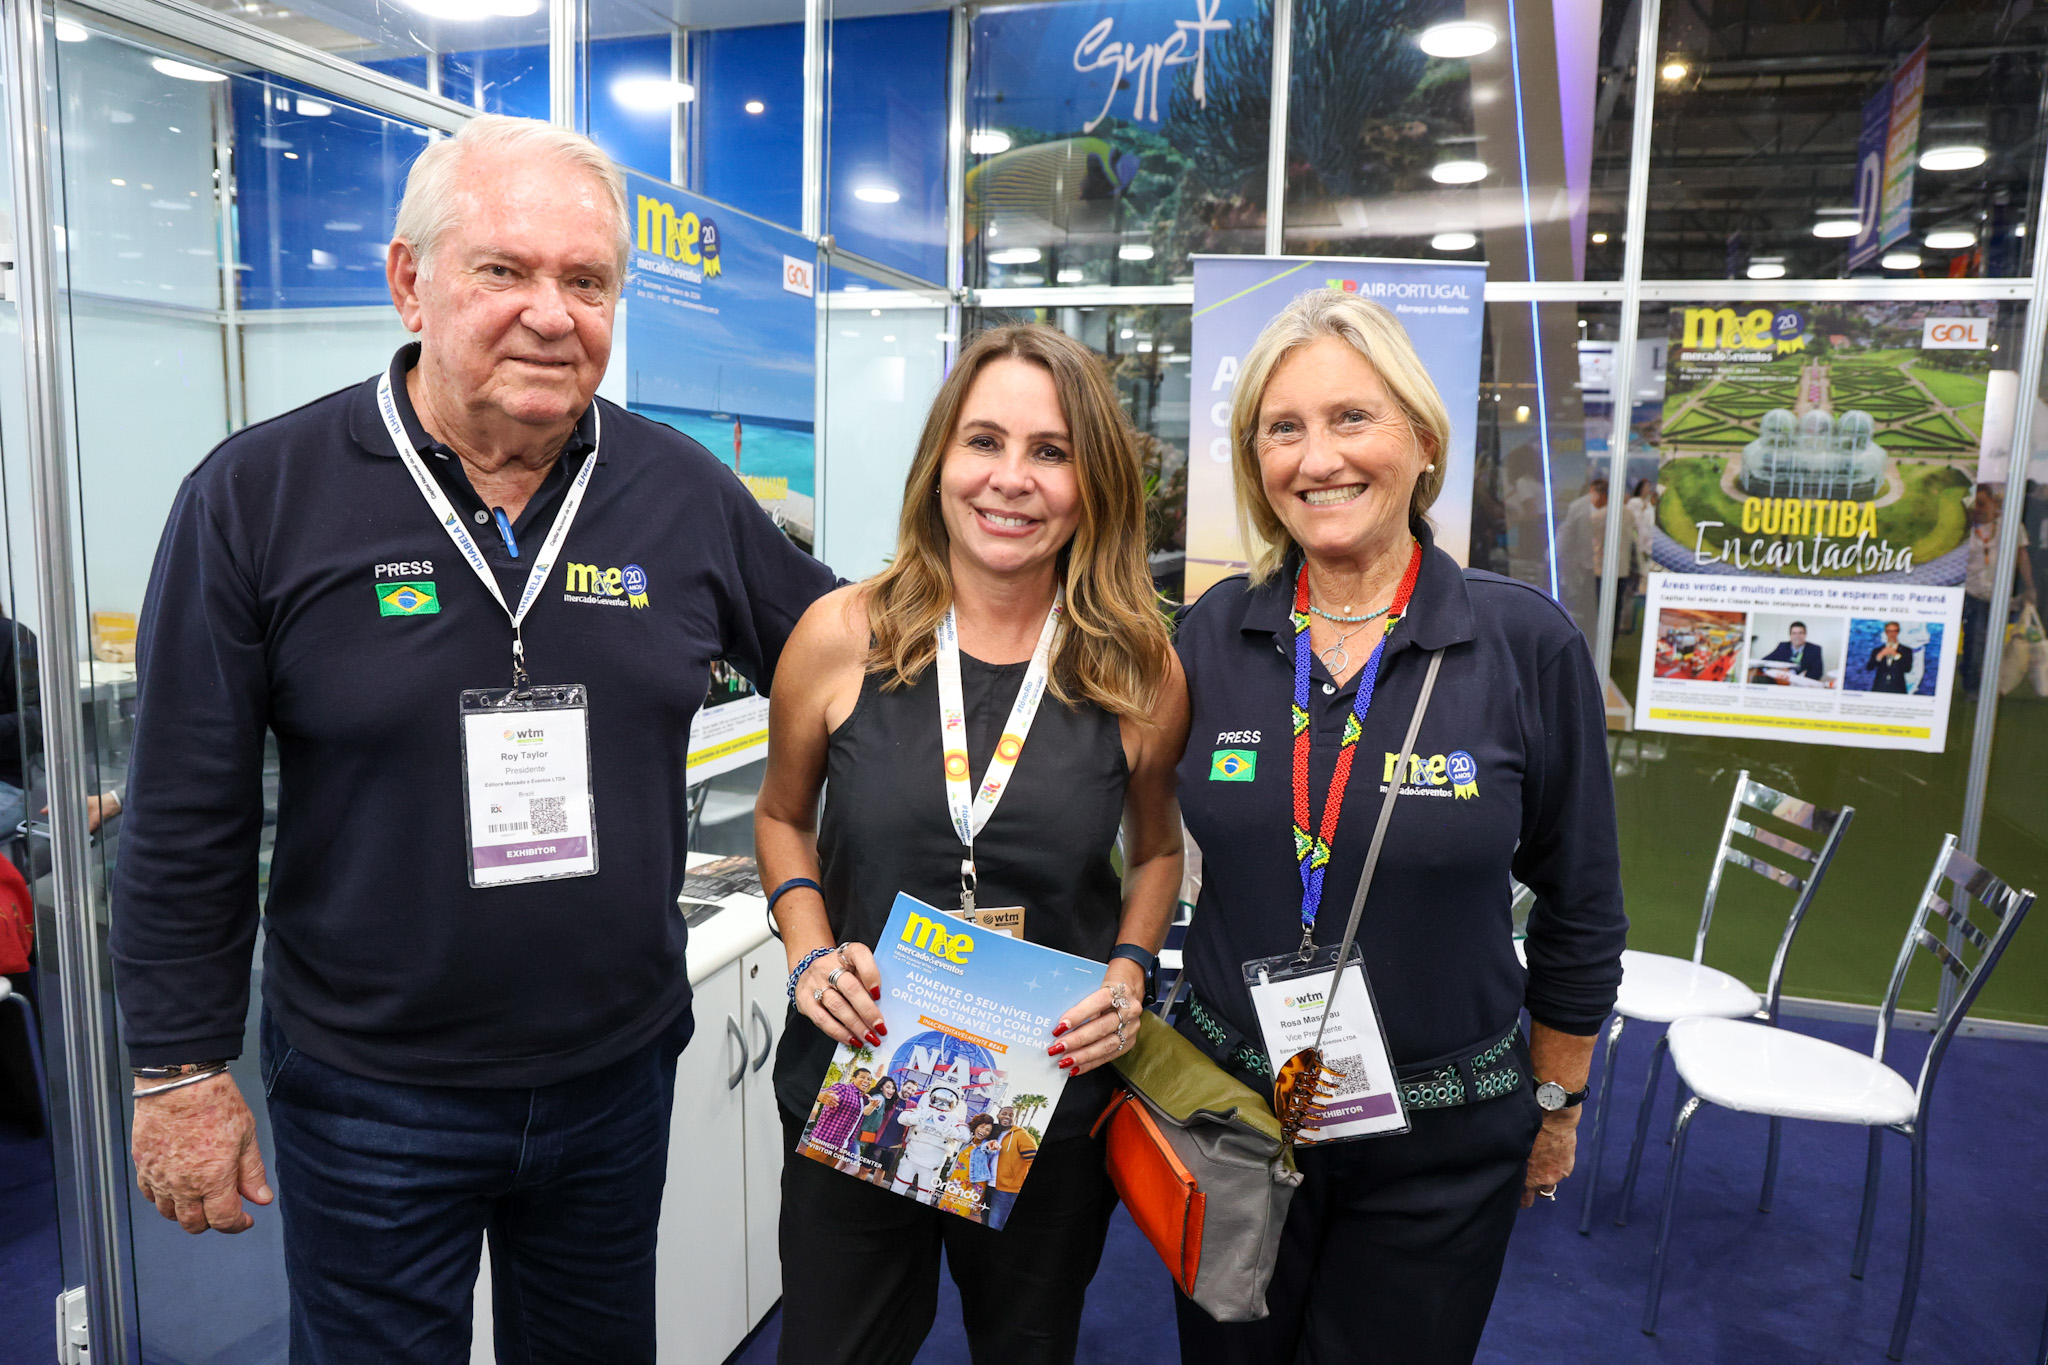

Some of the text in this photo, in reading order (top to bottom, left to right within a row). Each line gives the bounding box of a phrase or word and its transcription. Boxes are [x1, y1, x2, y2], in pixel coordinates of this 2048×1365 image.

[702, 226, 716, 244] 20
[786, 264, 810, 290] GOL
[1437, 305, 1470, 315] Mundo
[1777, 313, 1798, 330] 20
[1931, 324, 1979, 342] GOL
[382, 392, 401, 435] ILHABELA
[1741, 496, 1878, 539] CURITIBA
[453, 525, 485, 571] ILHABELA
[1694, 520, 1914, 575] Encantadora
[375, 560, 434, 578] PRESS
[625, 569, 642, 585] 20
[517, 573, 543, 616] ILHABELA
[1662, 578, 1691, 590] Áreas
[1694, 581, 1728, 592] verdes
[1741, 584, 1776, 595] muitos
[1842, 589, 1889, 601] esperam
[517, 728, 544, 739] wtm
[1215, 730, 1262, 745] PRESS
[501, 751, 549, 762] Roy Taylor
[1451, 756, 1470, 772] 20
[505, 766, 546, 775] Presidente
[1454, 771, 1472, 780] ANOS
[506, 845, 557, 859] EXHIBITOR
[994, 912, 1019, 923] wtm
[896, 943, 965, 976] mercado&eventos
[906, 970, 1052, 1028] AUMENTE O SEU NÍVEL DE
[1296, 992, 1324, 1004] wtm
[907, 982, 1042, 1037] CONHECIMENTO COM O
[891, 988, 1051, 1051] ORLANDO TRAVEL ACADEMY
[1280, 1019, 1302, 1029] Rosa
[922, 1018, 1005, 1052] INACREDITAVELMENTE REAL
[1285, 1024, 1343, 1042] Vice Presdente
[809, 1142, 862, 1168] VISITOR COMPLEX
[811, 1135, 883, 1169] KENNEDY SPACE CENTER
[930, 1176, 981, 1202] Orlando
